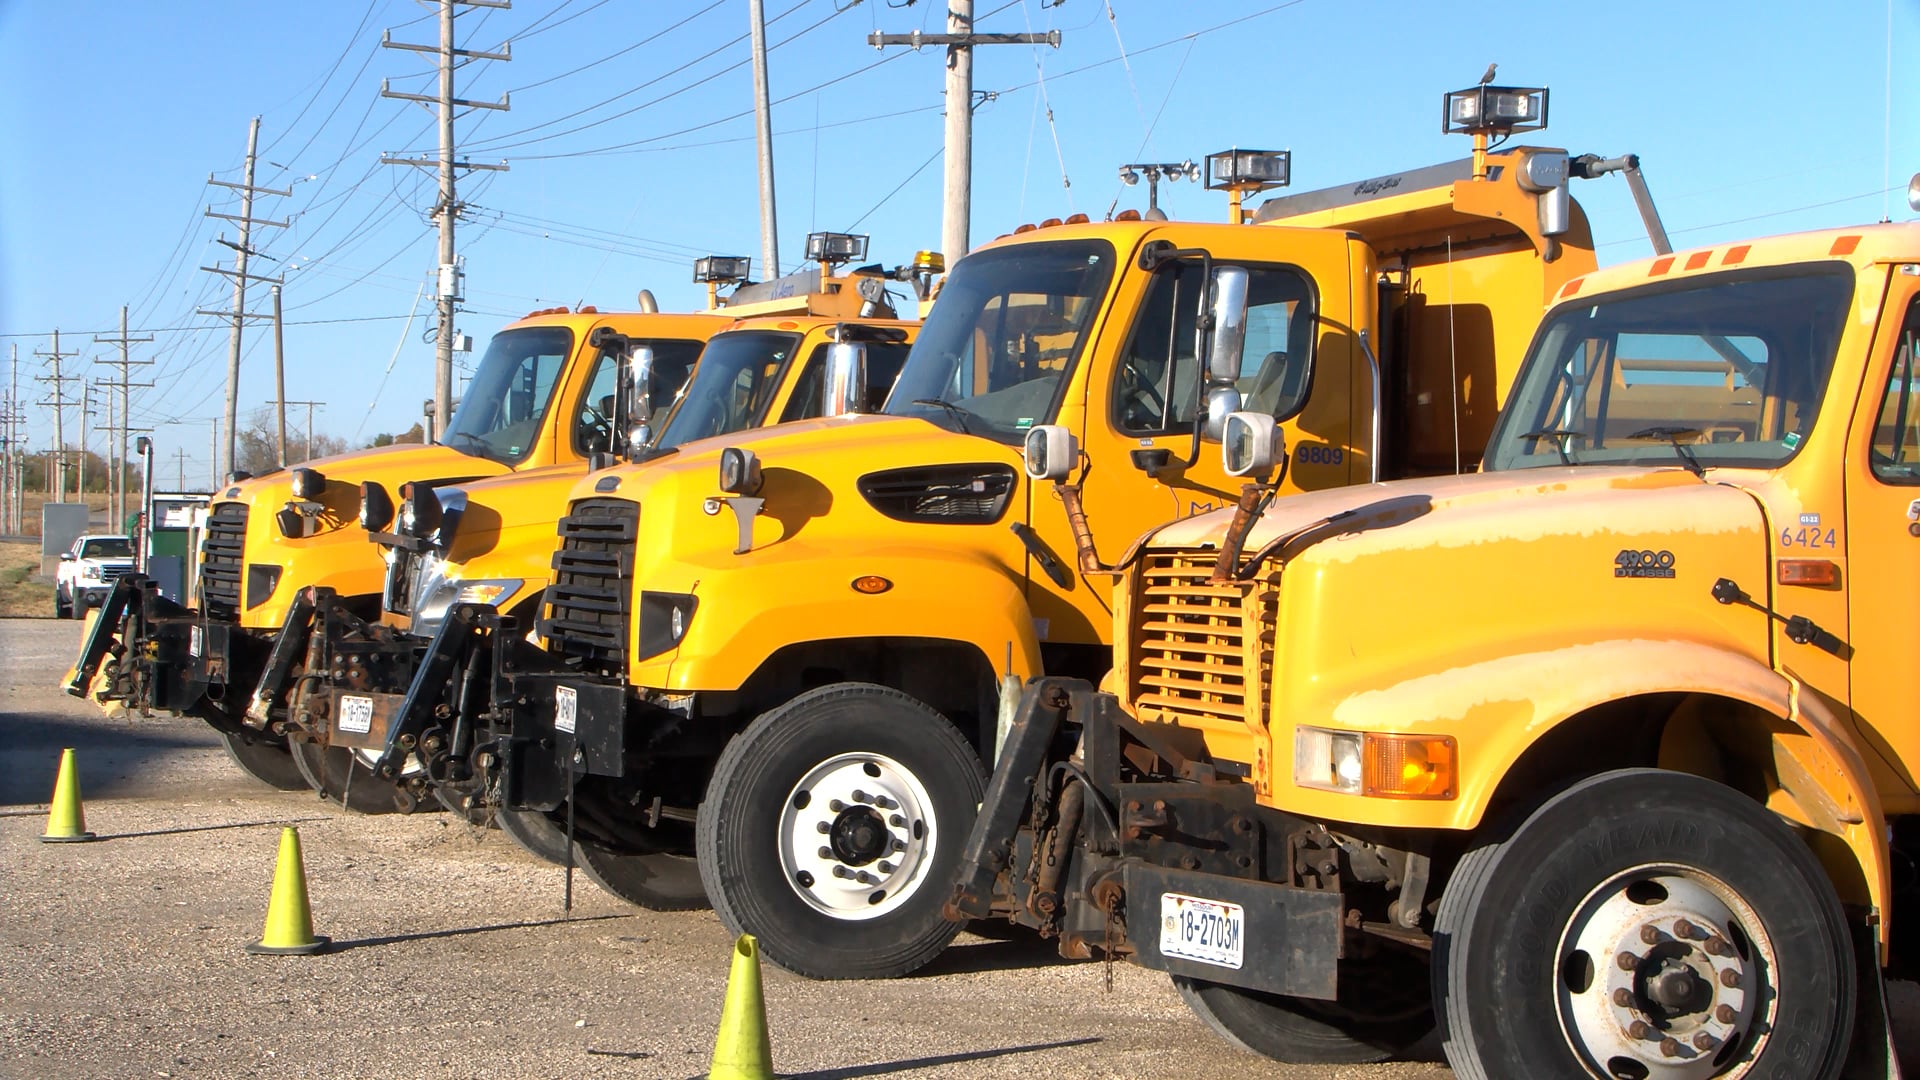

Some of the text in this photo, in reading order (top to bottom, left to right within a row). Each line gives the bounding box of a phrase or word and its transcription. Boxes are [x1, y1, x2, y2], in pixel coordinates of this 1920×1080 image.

[1298, 446, 1343, 465] 9809
[1781, 527, 1836, 549] 6424
[1615, 549, 1675, 569] 4900
[1180, 909, 1239, 951] 18-2703M
